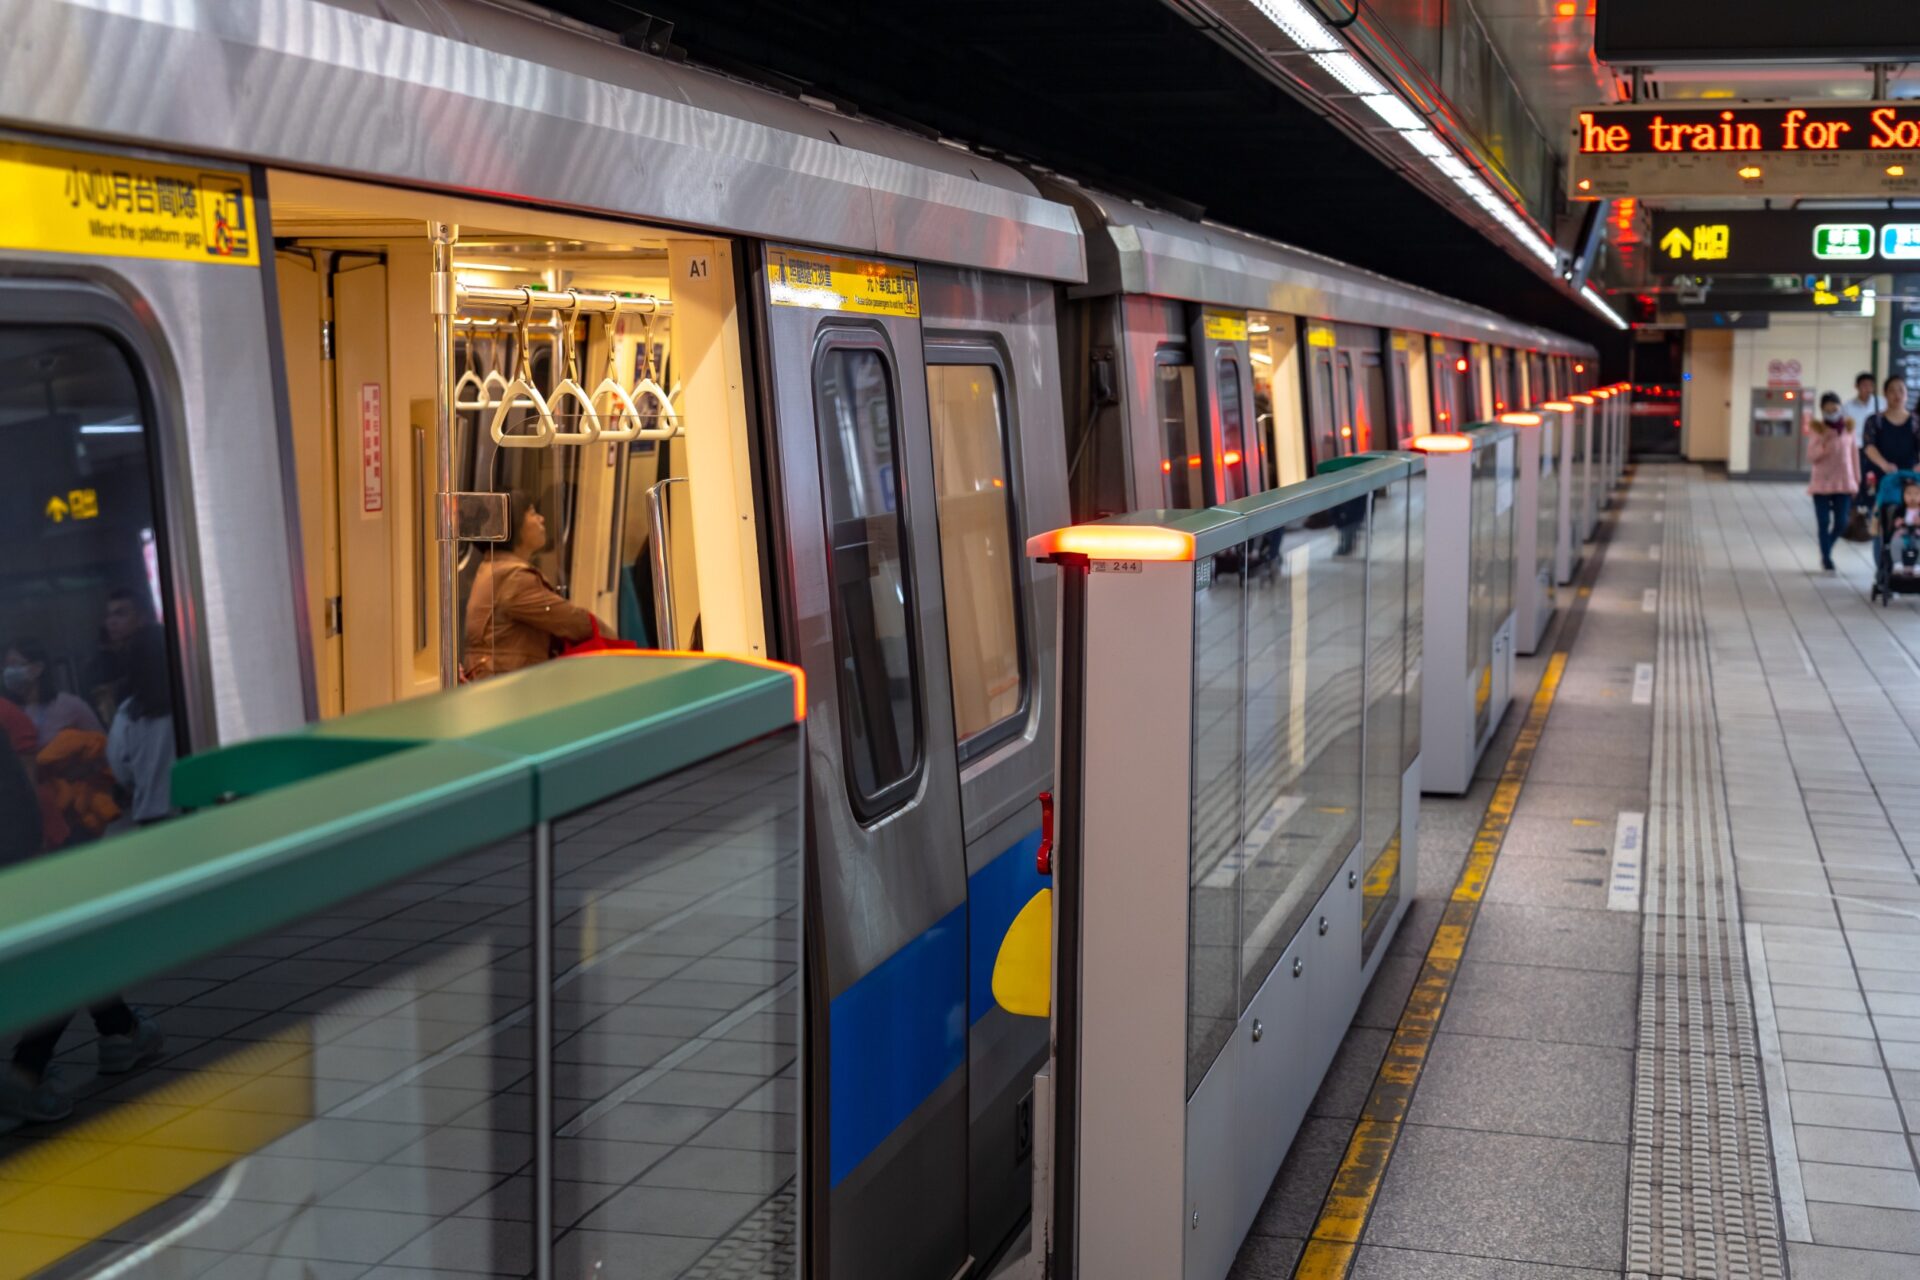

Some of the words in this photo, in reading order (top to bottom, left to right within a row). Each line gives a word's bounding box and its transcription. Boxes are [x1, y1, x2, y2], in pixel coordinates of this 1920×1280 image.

[1648, 111, 1762, 151] train
[1781, 109, 1851, 150] for
[1870, 108, 1920, 148] So
[120, 223, 135, 239] the
[690, 259, 707, 277] A1
[1113, 561, 1137, 571] 244
